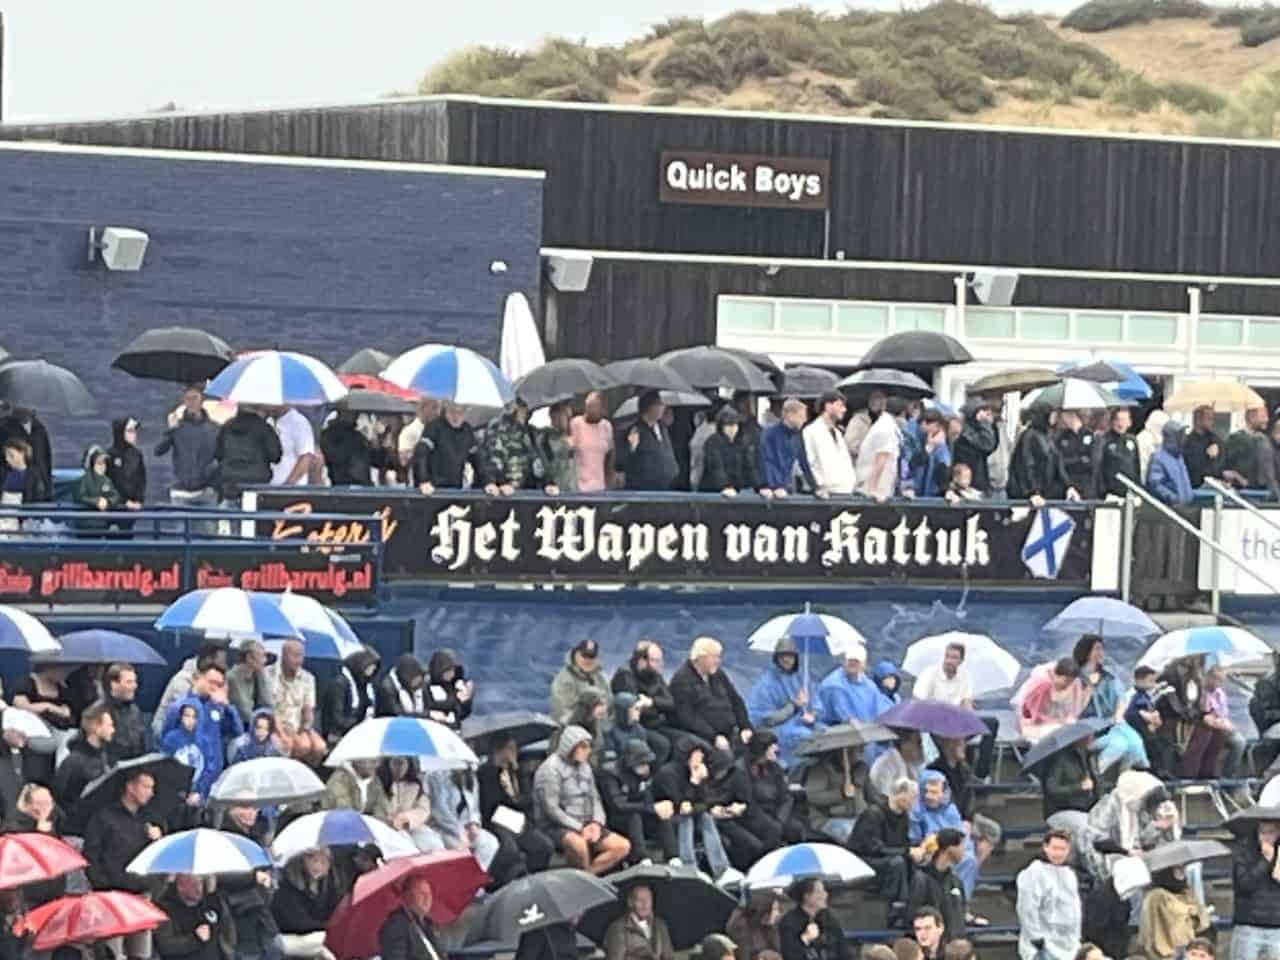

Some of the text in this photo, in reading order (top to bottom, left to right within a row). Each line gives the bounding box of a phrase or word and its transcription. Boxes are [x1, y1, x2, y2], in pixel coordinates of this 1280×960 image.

[666, 160, 821, 201] Quick Boys
[429, 504, 992, 571] Het Wapen van Kattuk
[39, 560, 181, 597] grillbarruig.nl
